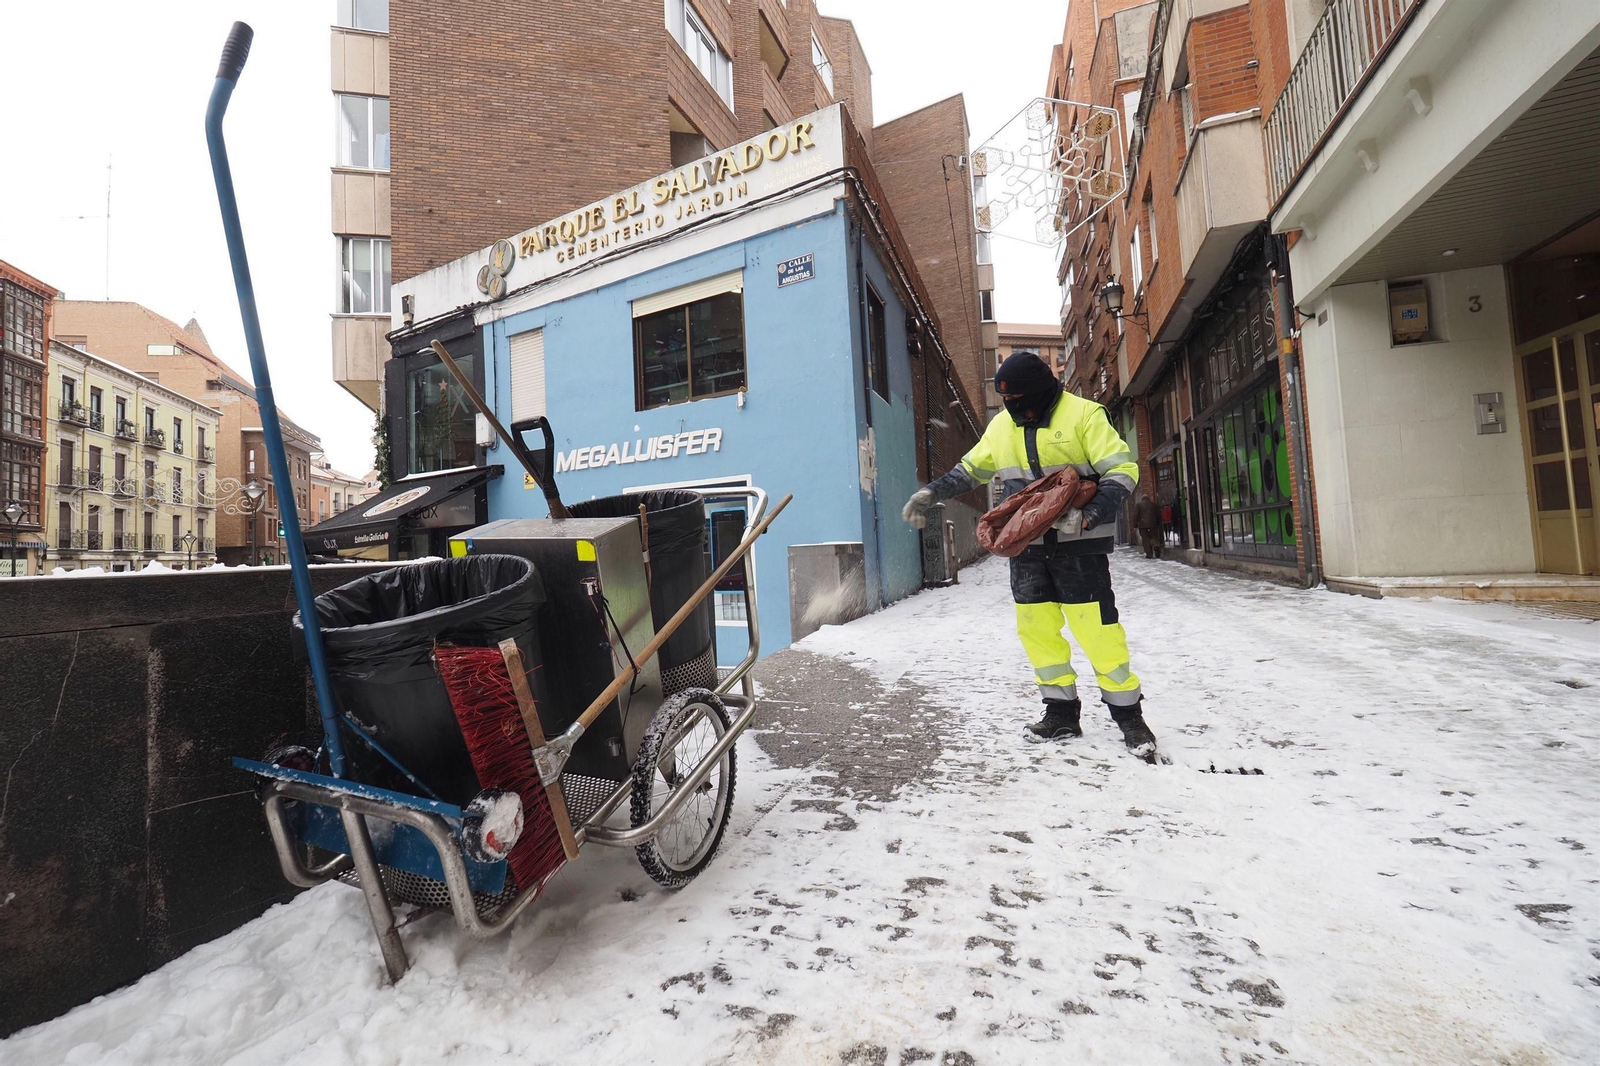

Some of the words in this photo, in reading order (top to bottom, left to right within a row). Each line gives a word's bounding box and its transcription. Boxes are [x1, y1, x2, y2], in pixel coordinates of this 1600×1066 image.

[518, 205, 606, 258] PARQUE
[613, 191, 644, 223] EL
[653, 121, 815, 206] SALVADOR
[556, 214, 664, 263] CEMENTERIO
[675, 181, 748, 220] JARDIN
[782, 270, 811, 284] ANGUSTIAS
[789, 255, 812, 268] CALLE
[1468, 295, 1483, 313] 3
[556, 427, 722, 473] MEGALUISFER
